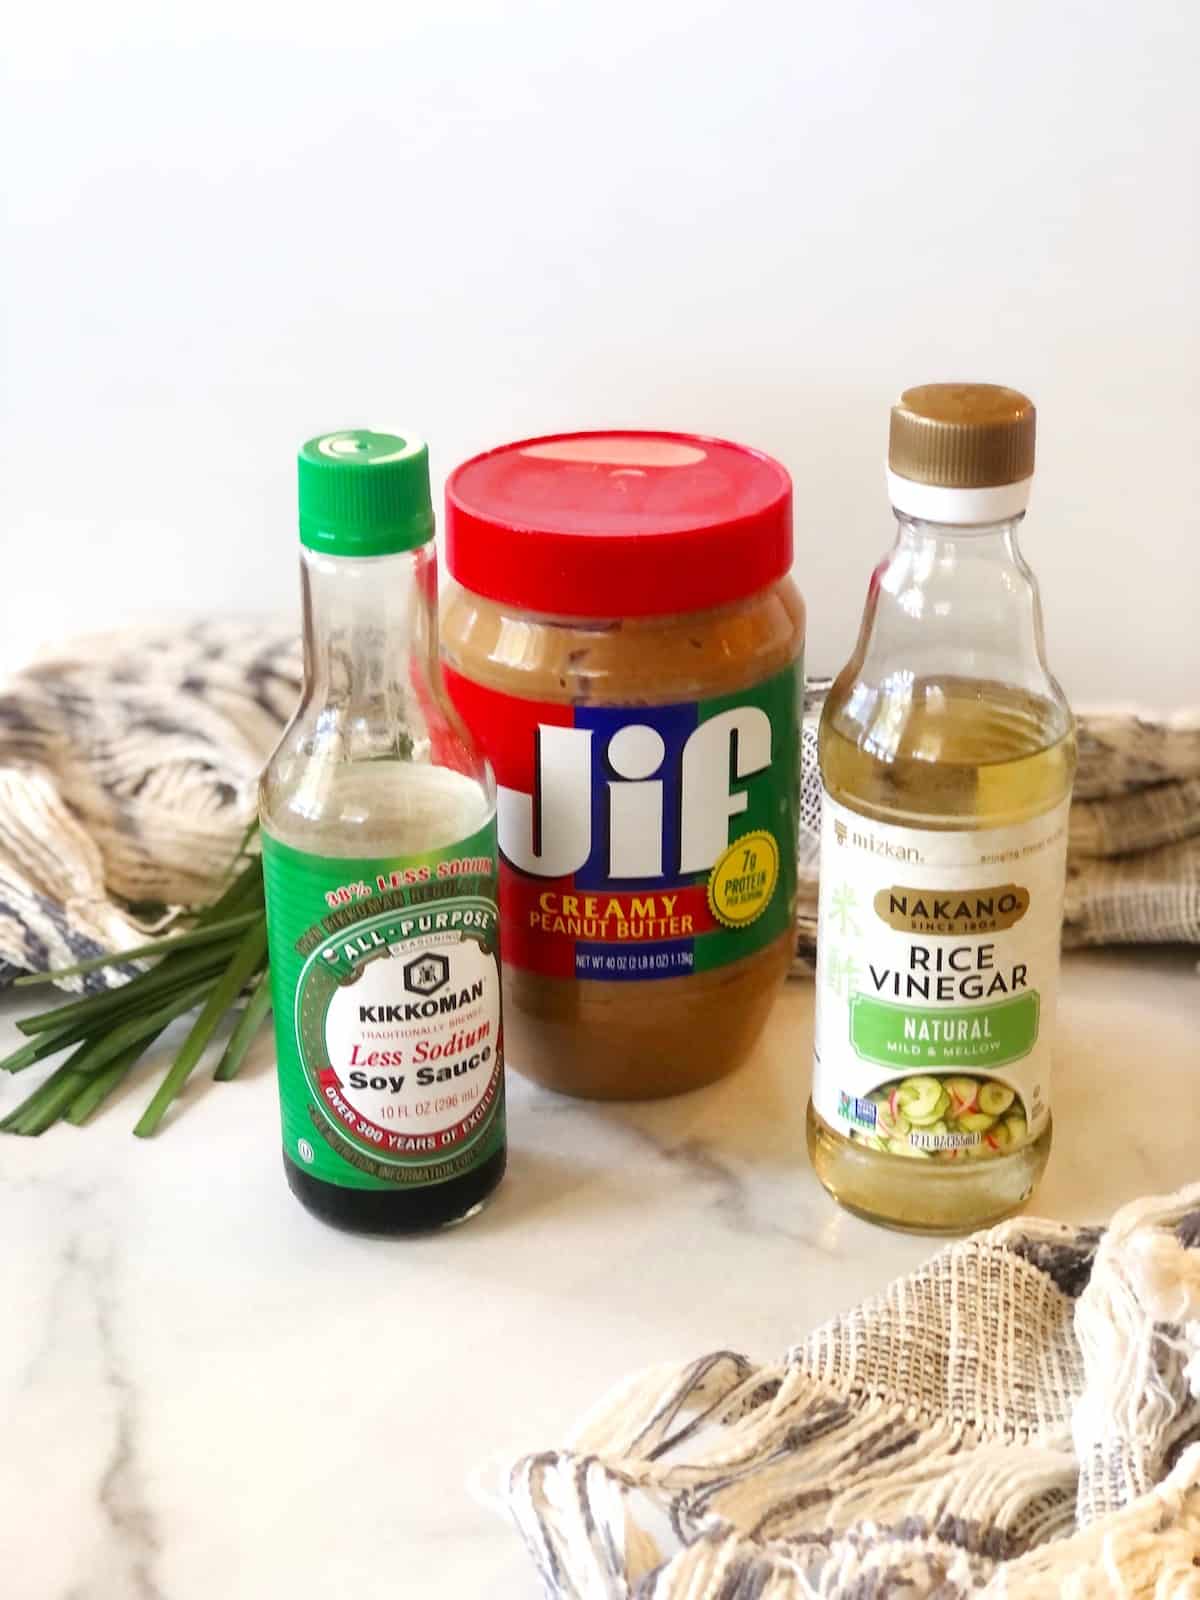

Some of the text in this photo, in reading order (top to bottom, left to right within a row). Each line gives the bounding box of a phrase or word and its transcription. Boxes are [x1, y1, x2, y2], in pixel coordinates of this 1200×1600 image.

[497, 706, 772, 878] Jif
[743, 850, 757, 872] 7g
[852, 832, 919, 864] mizkan
[375, 864, 430, 893] LESS
[539, 892, 679, 918] CREAMY
[889, 894, 1017, 919] NAKANO
[530, 911, 694, 939] PEANUT BUTTER
[911, 920, 955, 931] SINCE
[576, 954, 590, 969] NET
[592, 956, 604, 969] WT
[606, 956, 616, 970] 40
[617, 956, 627, 971] OZ
[638, 956, 648, 969] LB
[649, 954, 656, 969] 8
[910, 944, 995, 973] RICE
[869, 963, 1028, 1002] VINEGAR
[359, 981, 484, 1024] KIKKOMAN
[904, 1016, 992, 1043] NATURAL
[350, 1020, 491, 1069] Less Sodium
[887, 1040, 1000, 1058] MILD & MELLOW
[349, 1045, 492, 1094] Soy Sauce
[325, 1087, 356, 1124] OVER
[356, 1121, 384, 1143] 300
[388, 1133, 436, 1151] YEARS
[441, 1129, 458, 1146] OF
[380, 1104, 394, 1120] 10
[398, 1103, 408, 1119] FL
[415, 1100, 431, 1116] OZ
[911, 1135, 920, 1148] 12
